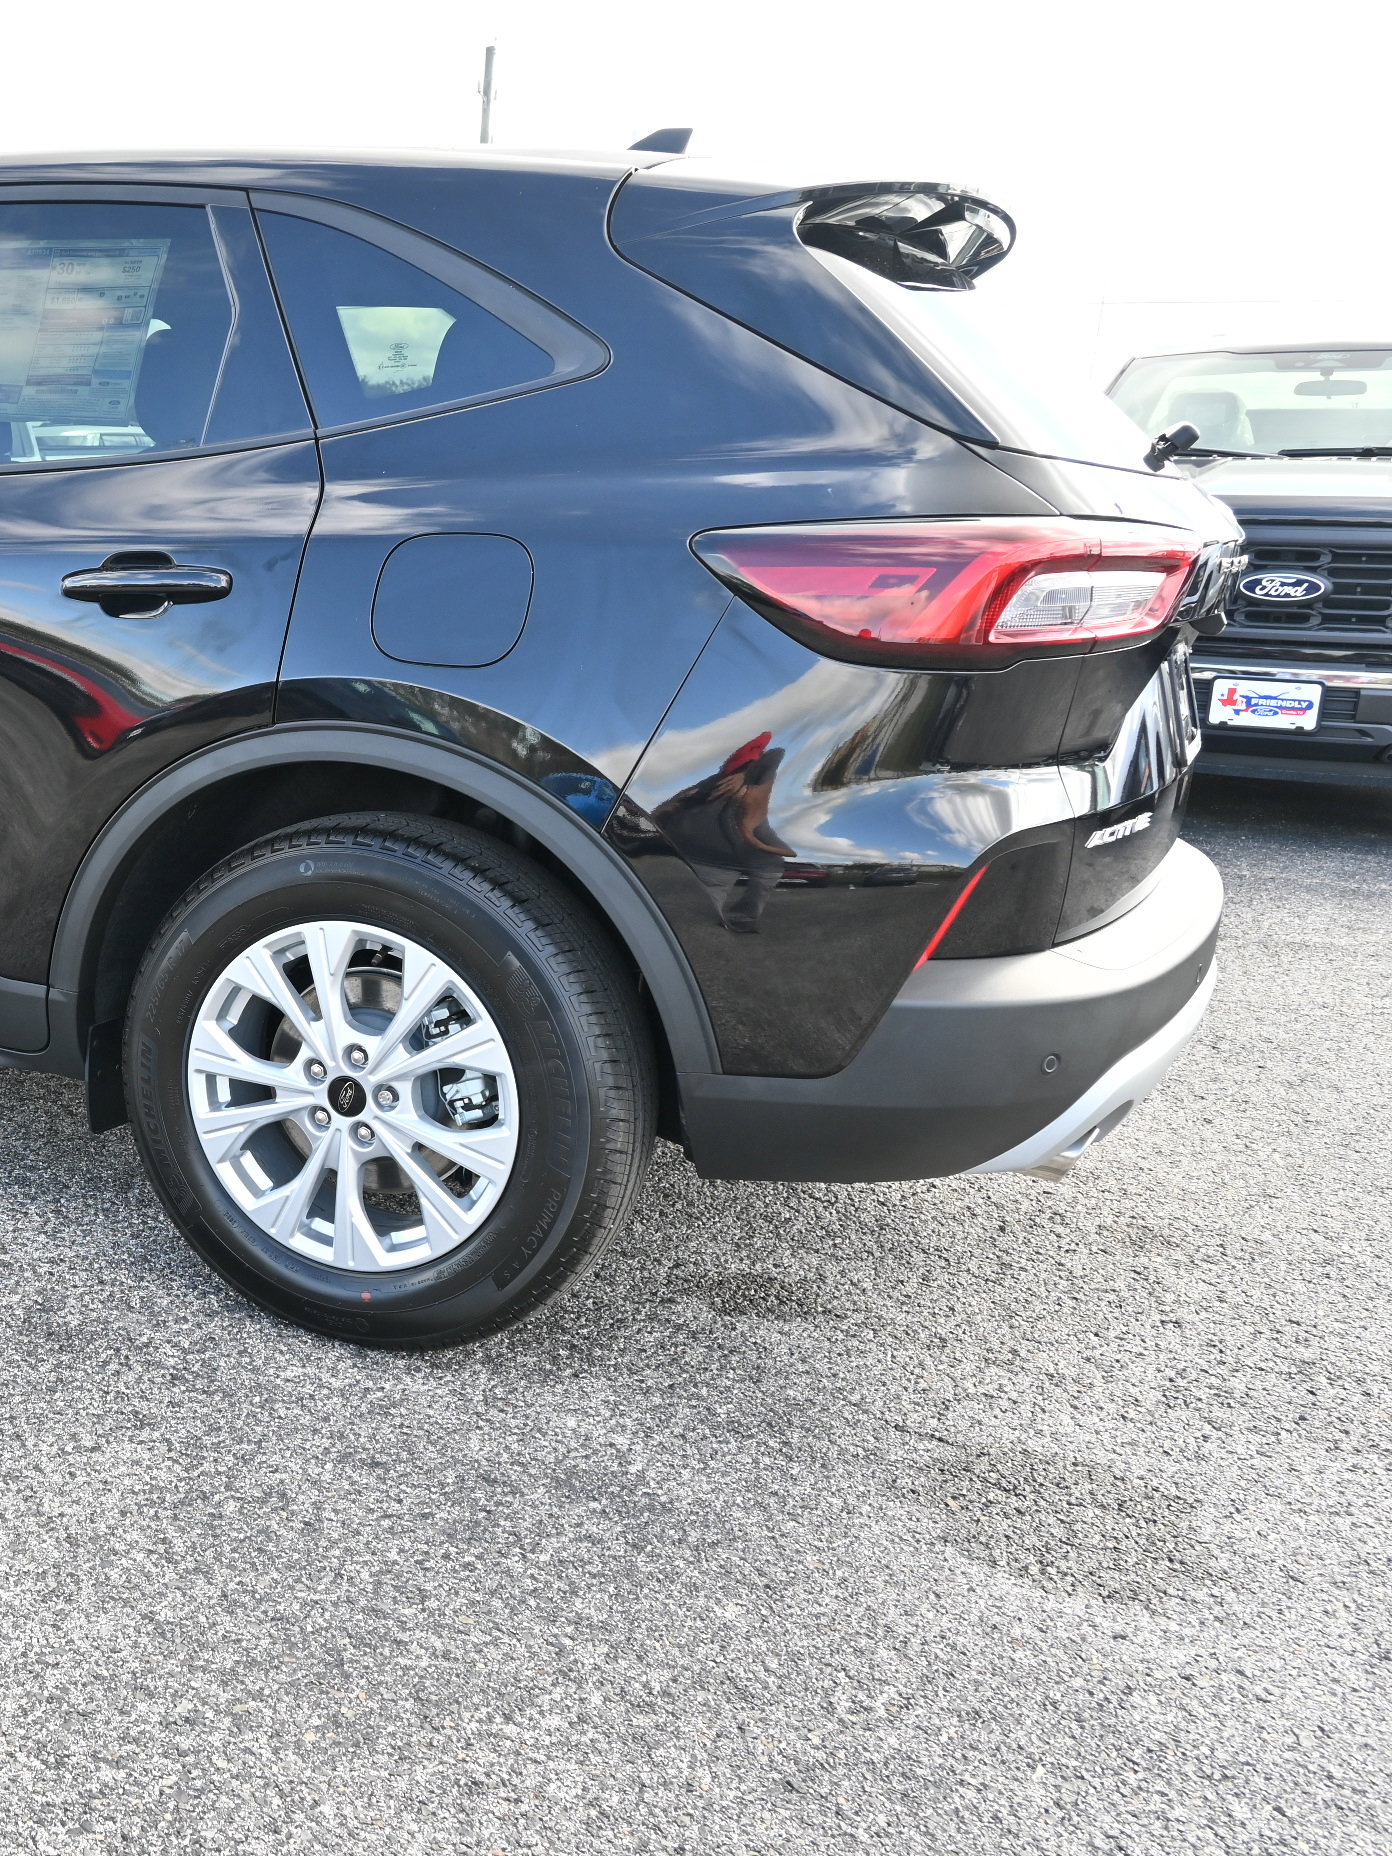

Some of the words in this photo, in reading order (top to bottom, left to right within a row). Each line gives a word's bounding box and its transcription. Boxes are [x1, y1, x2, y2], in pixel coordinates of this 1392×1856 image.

[1255, 576, 1309, 597] Ford
[1250, 698, 1310, 709] FRIENDLY
[520, 1187, 562, 1260] PRIMACY
